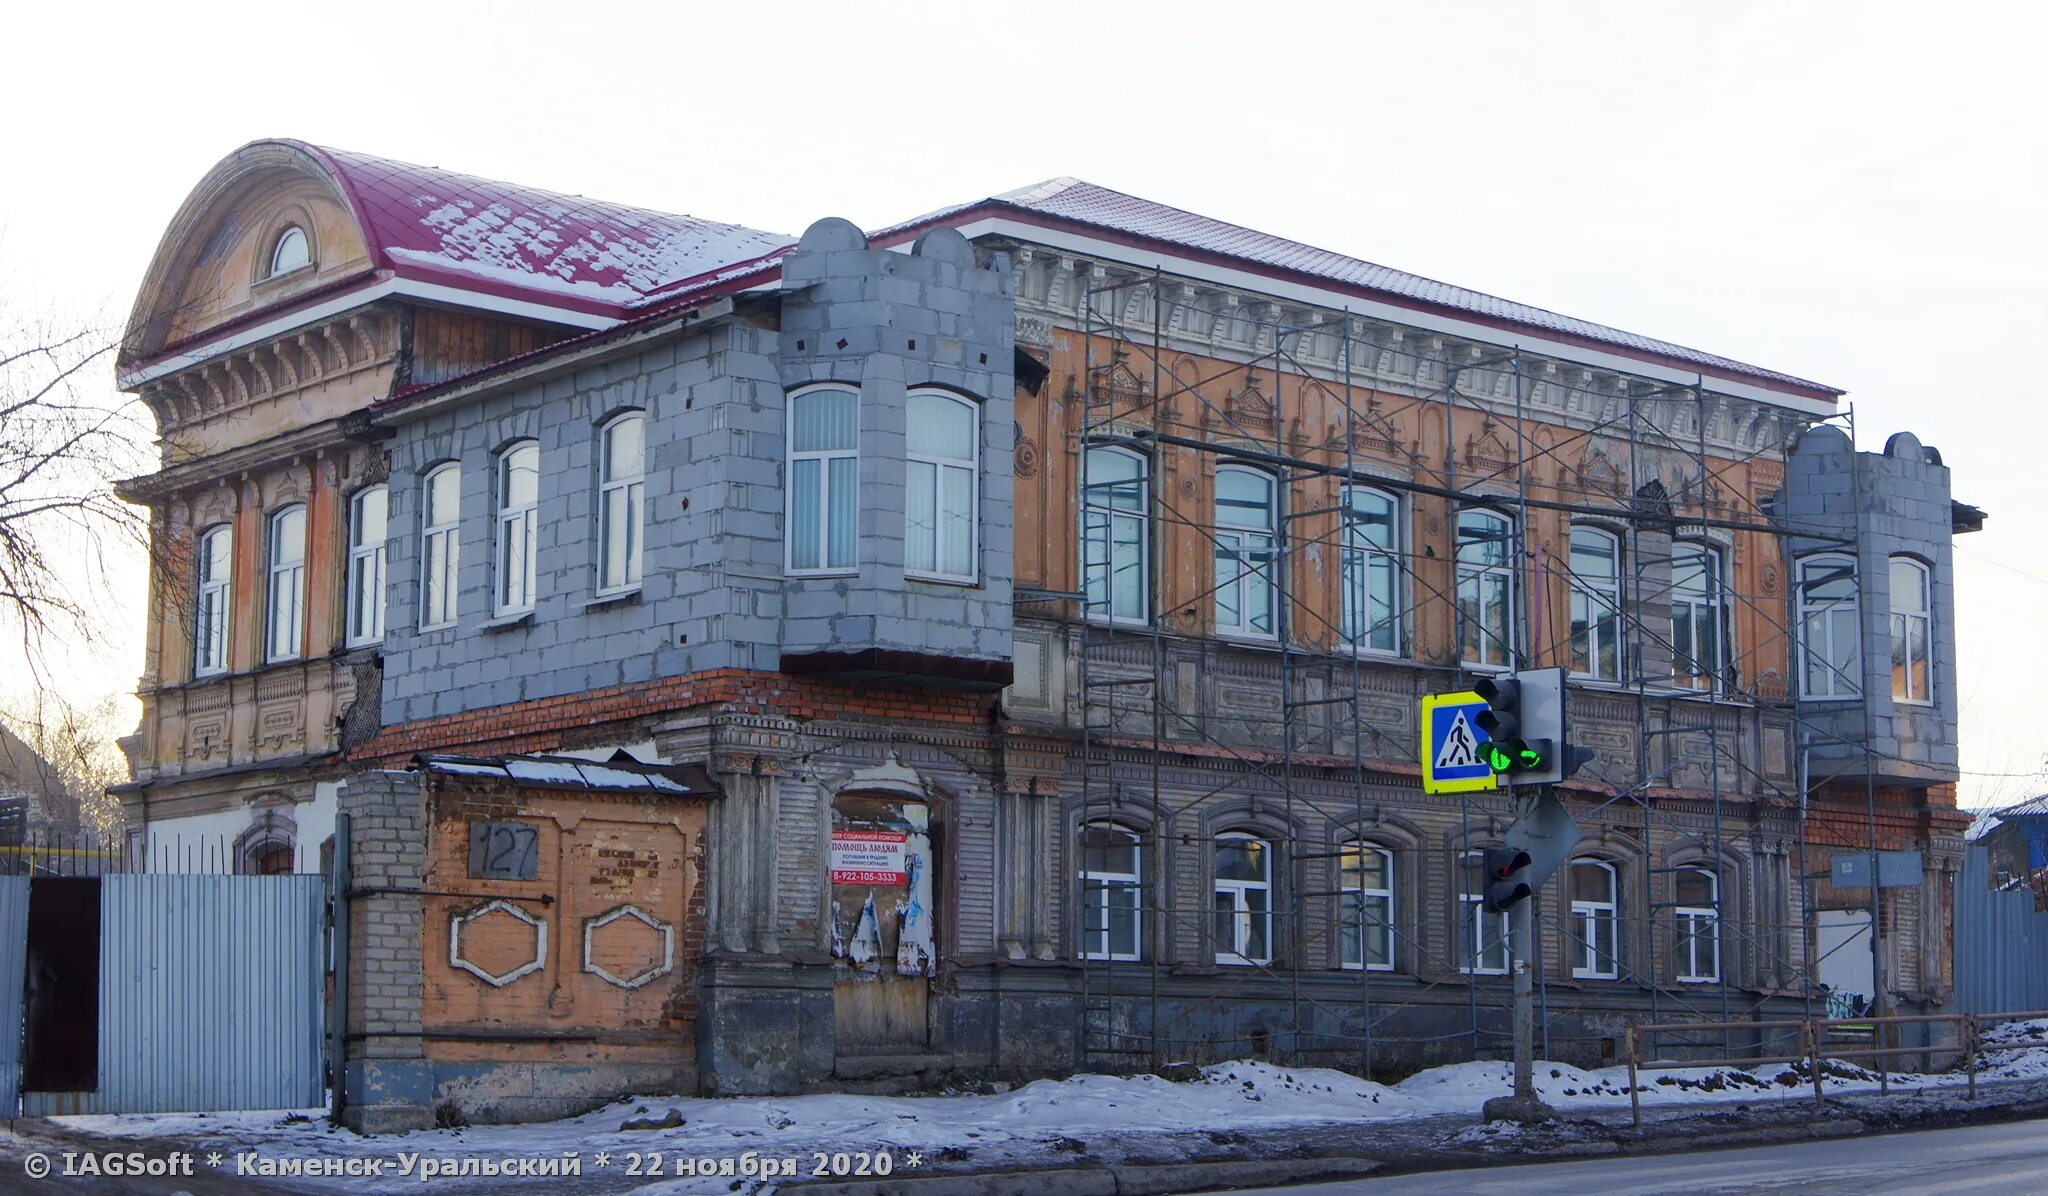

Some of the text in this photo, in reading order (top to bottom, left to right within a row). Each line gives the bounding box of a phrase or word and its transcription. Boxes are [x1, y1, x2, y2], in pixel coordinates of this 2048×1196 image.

[480, 825, 538, 877] 127
[832, 843, 898, 854] ПОМОЩЬ ЛЮДЯМ
[833, 872, 897, 882] 8-922-105-3333
